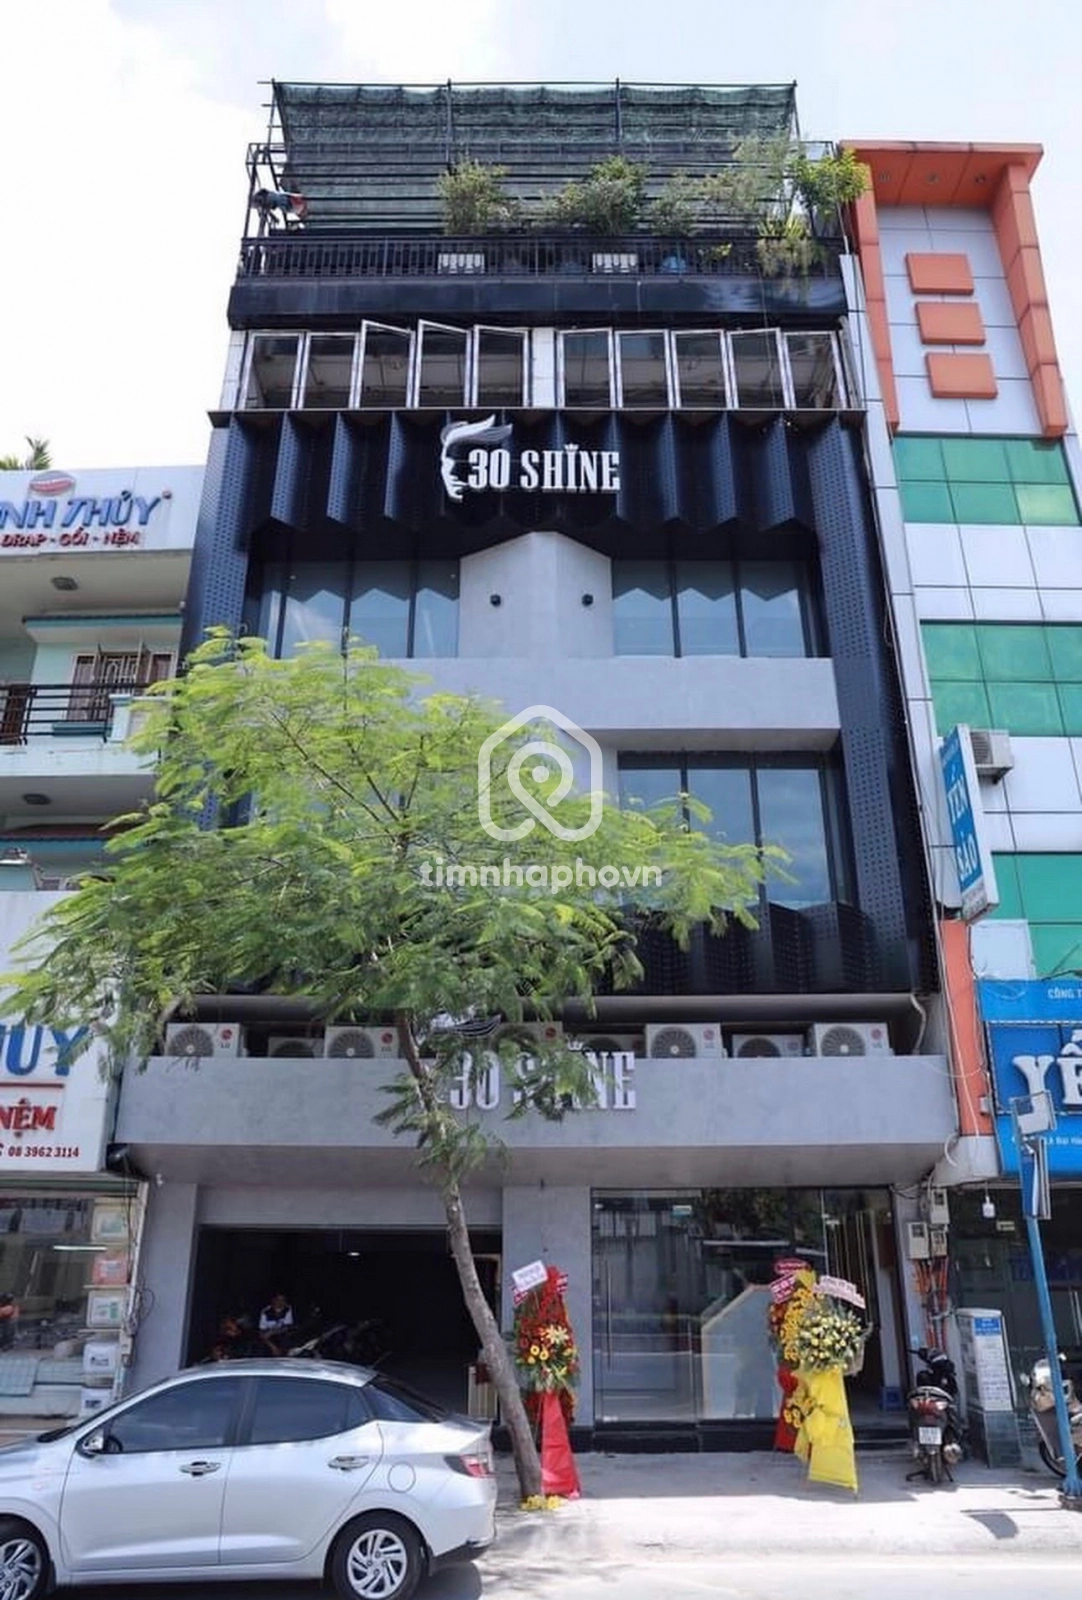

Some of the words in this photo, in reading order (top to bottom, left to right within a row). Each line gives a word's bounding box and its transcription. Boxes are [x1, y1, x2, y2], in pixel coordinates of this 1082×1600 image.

[468, 448, 510, 490] 30
[520, 445, 621, 491] SHINE
[61, 491, 161, 527] THỦY
[2, 534, 47, 548] DRAP
[8, 1145, 22, 1157] 08
[24, 1146, 52, 1158] 3962
[54, 1146, 79, 1158] 3114
